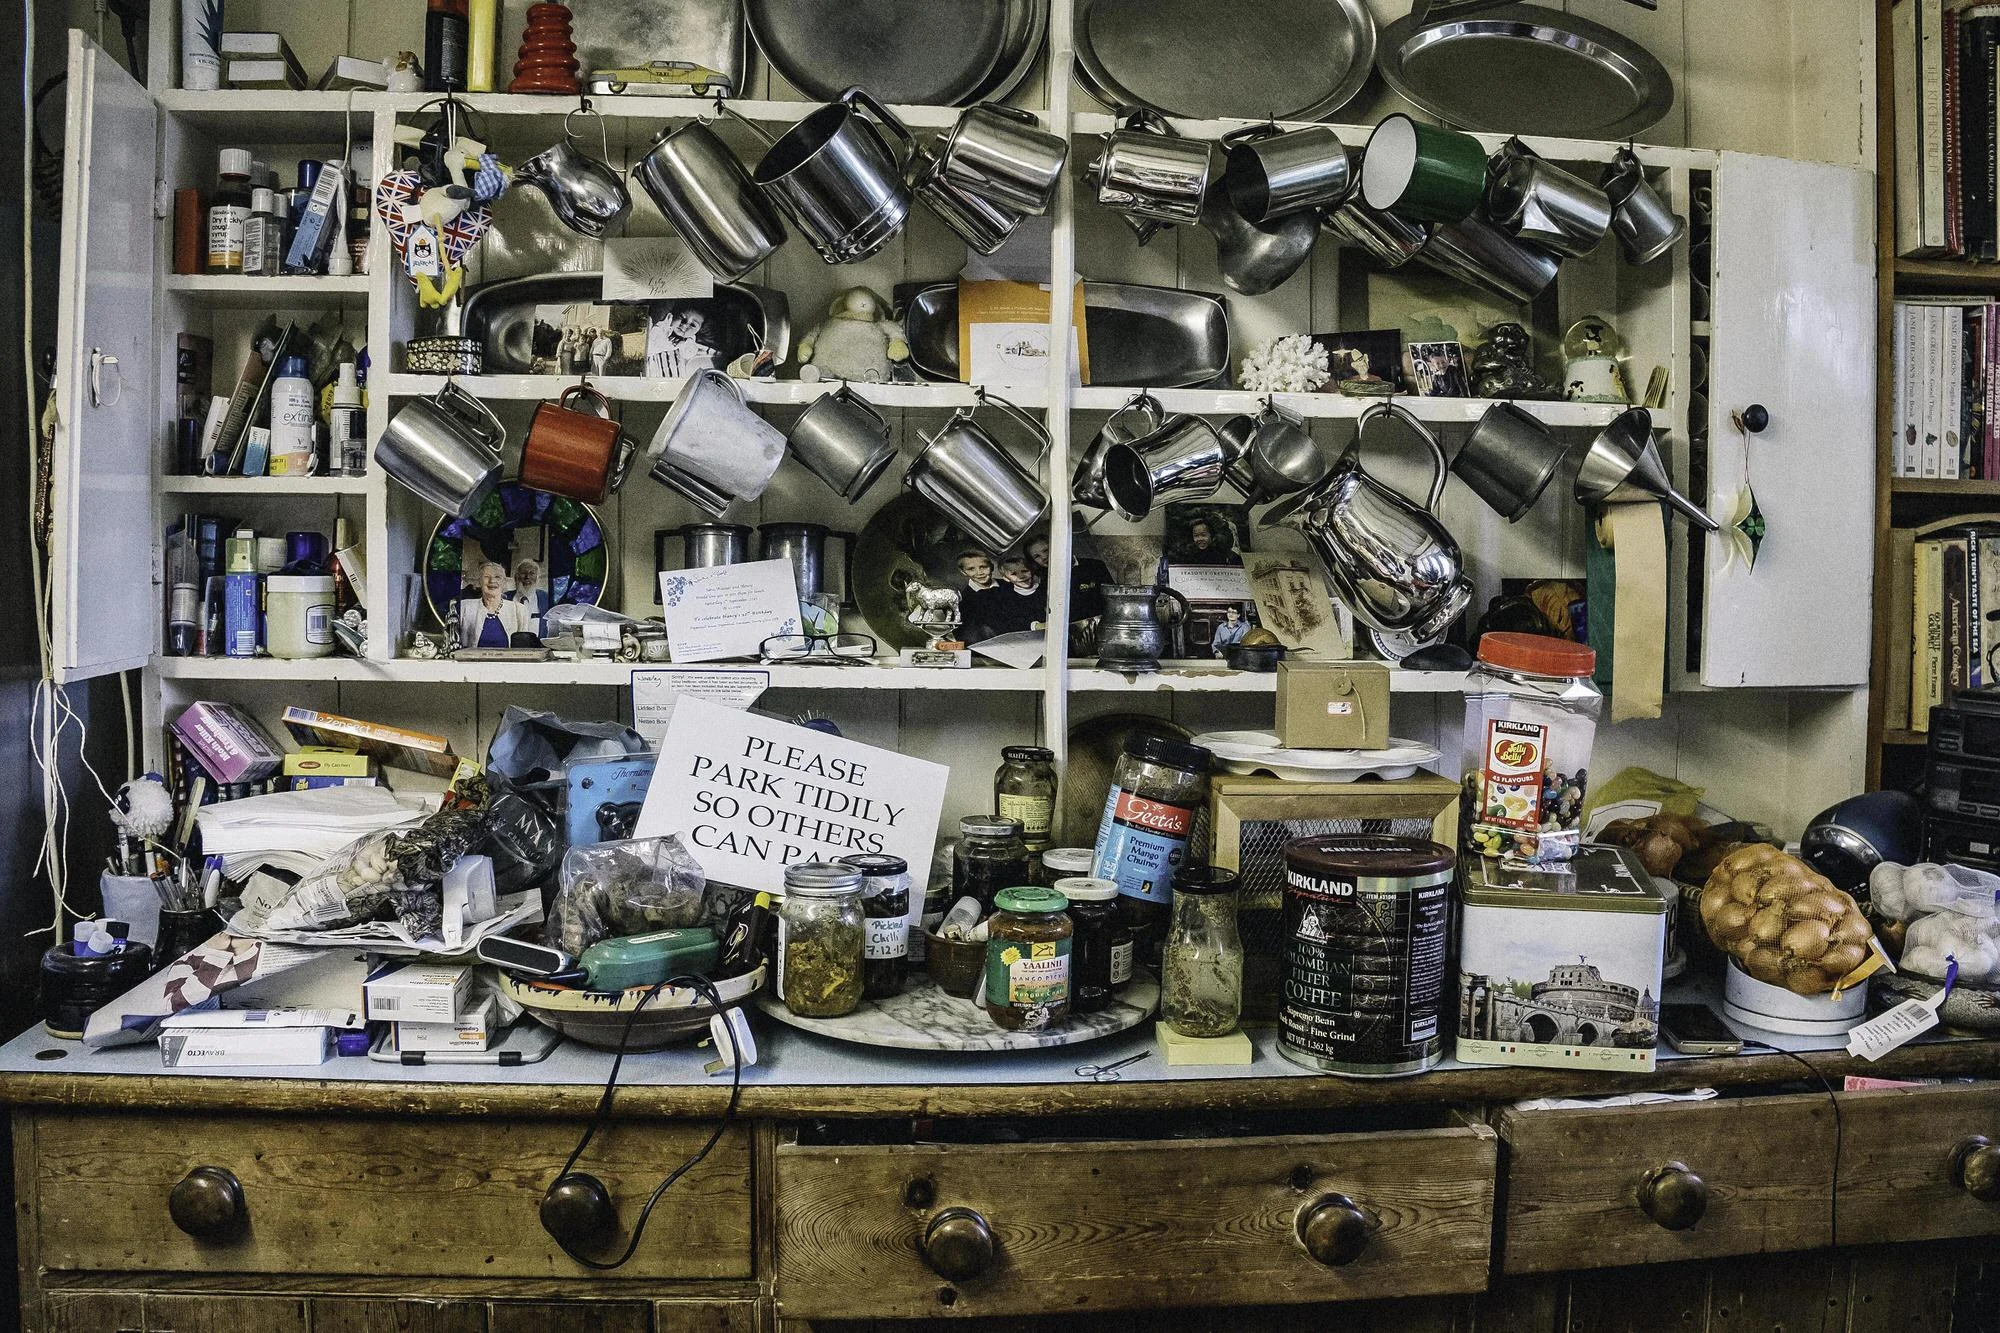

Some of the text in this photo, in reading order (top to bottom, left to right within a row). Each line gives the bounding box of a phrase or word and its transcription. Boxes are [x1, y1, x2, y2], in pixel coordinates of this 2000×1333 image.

[212, 216, 244, 226] Dry tckly
[1972, 609, 1978, 620] OF
[1949, 594, 1962, 687] American Cookery
[1498, 720, 1540, 732] KIRKLAND
[194, 724, 230, 761] Moth Killer
[1508, 742, 1527, 756] Jelly
[742, 736, 868, 788] PLEASE
[1500, 752, 1522, 766] Belly
[611, 767, 654, 781] Thornton
[1502, 775, 1534, 784] FLAVOURS
[689, 755, 905, 827] PARK TIDILY
[693, 790, 885, 855] SO OTHERS
[1124, 799, 1182, 831] Geeta's
[691, 824, 843, 866] CAN PA
[1130, 836, 1166, 852] Premium
[1131, 846, 1159, 860] Mango
[1127, 855, 1160, 870] Chutney
[1288, 870, 1354, 896] KIRKLAND
[1418, 888, 1445, 900] KIRKLAND
[872, 920, 904, 930] Pickled
[872, 930, 900, 944] Chilli
[1298, 944, 1326, 958] 100%
[1284, 951, 1351, 976] OLOMBIAN
[1292, 966, 1330, 987] FILTER
[1285, 980, 1342, 1008] COFFEE
[1287, 1006, 1336, 1027] Supremo Bean
[1414, 1018, 1436, 1029] KIRKLAND
[1288, 1018, 1304, 1032] Roast
[1310, 1027, 1328, 1038] Fine
[1329, 1031, 1356, 1042] Grind
[1286, 1031, 1296, 1042] NET
[1326, 1043, 1334, 1055] kg
